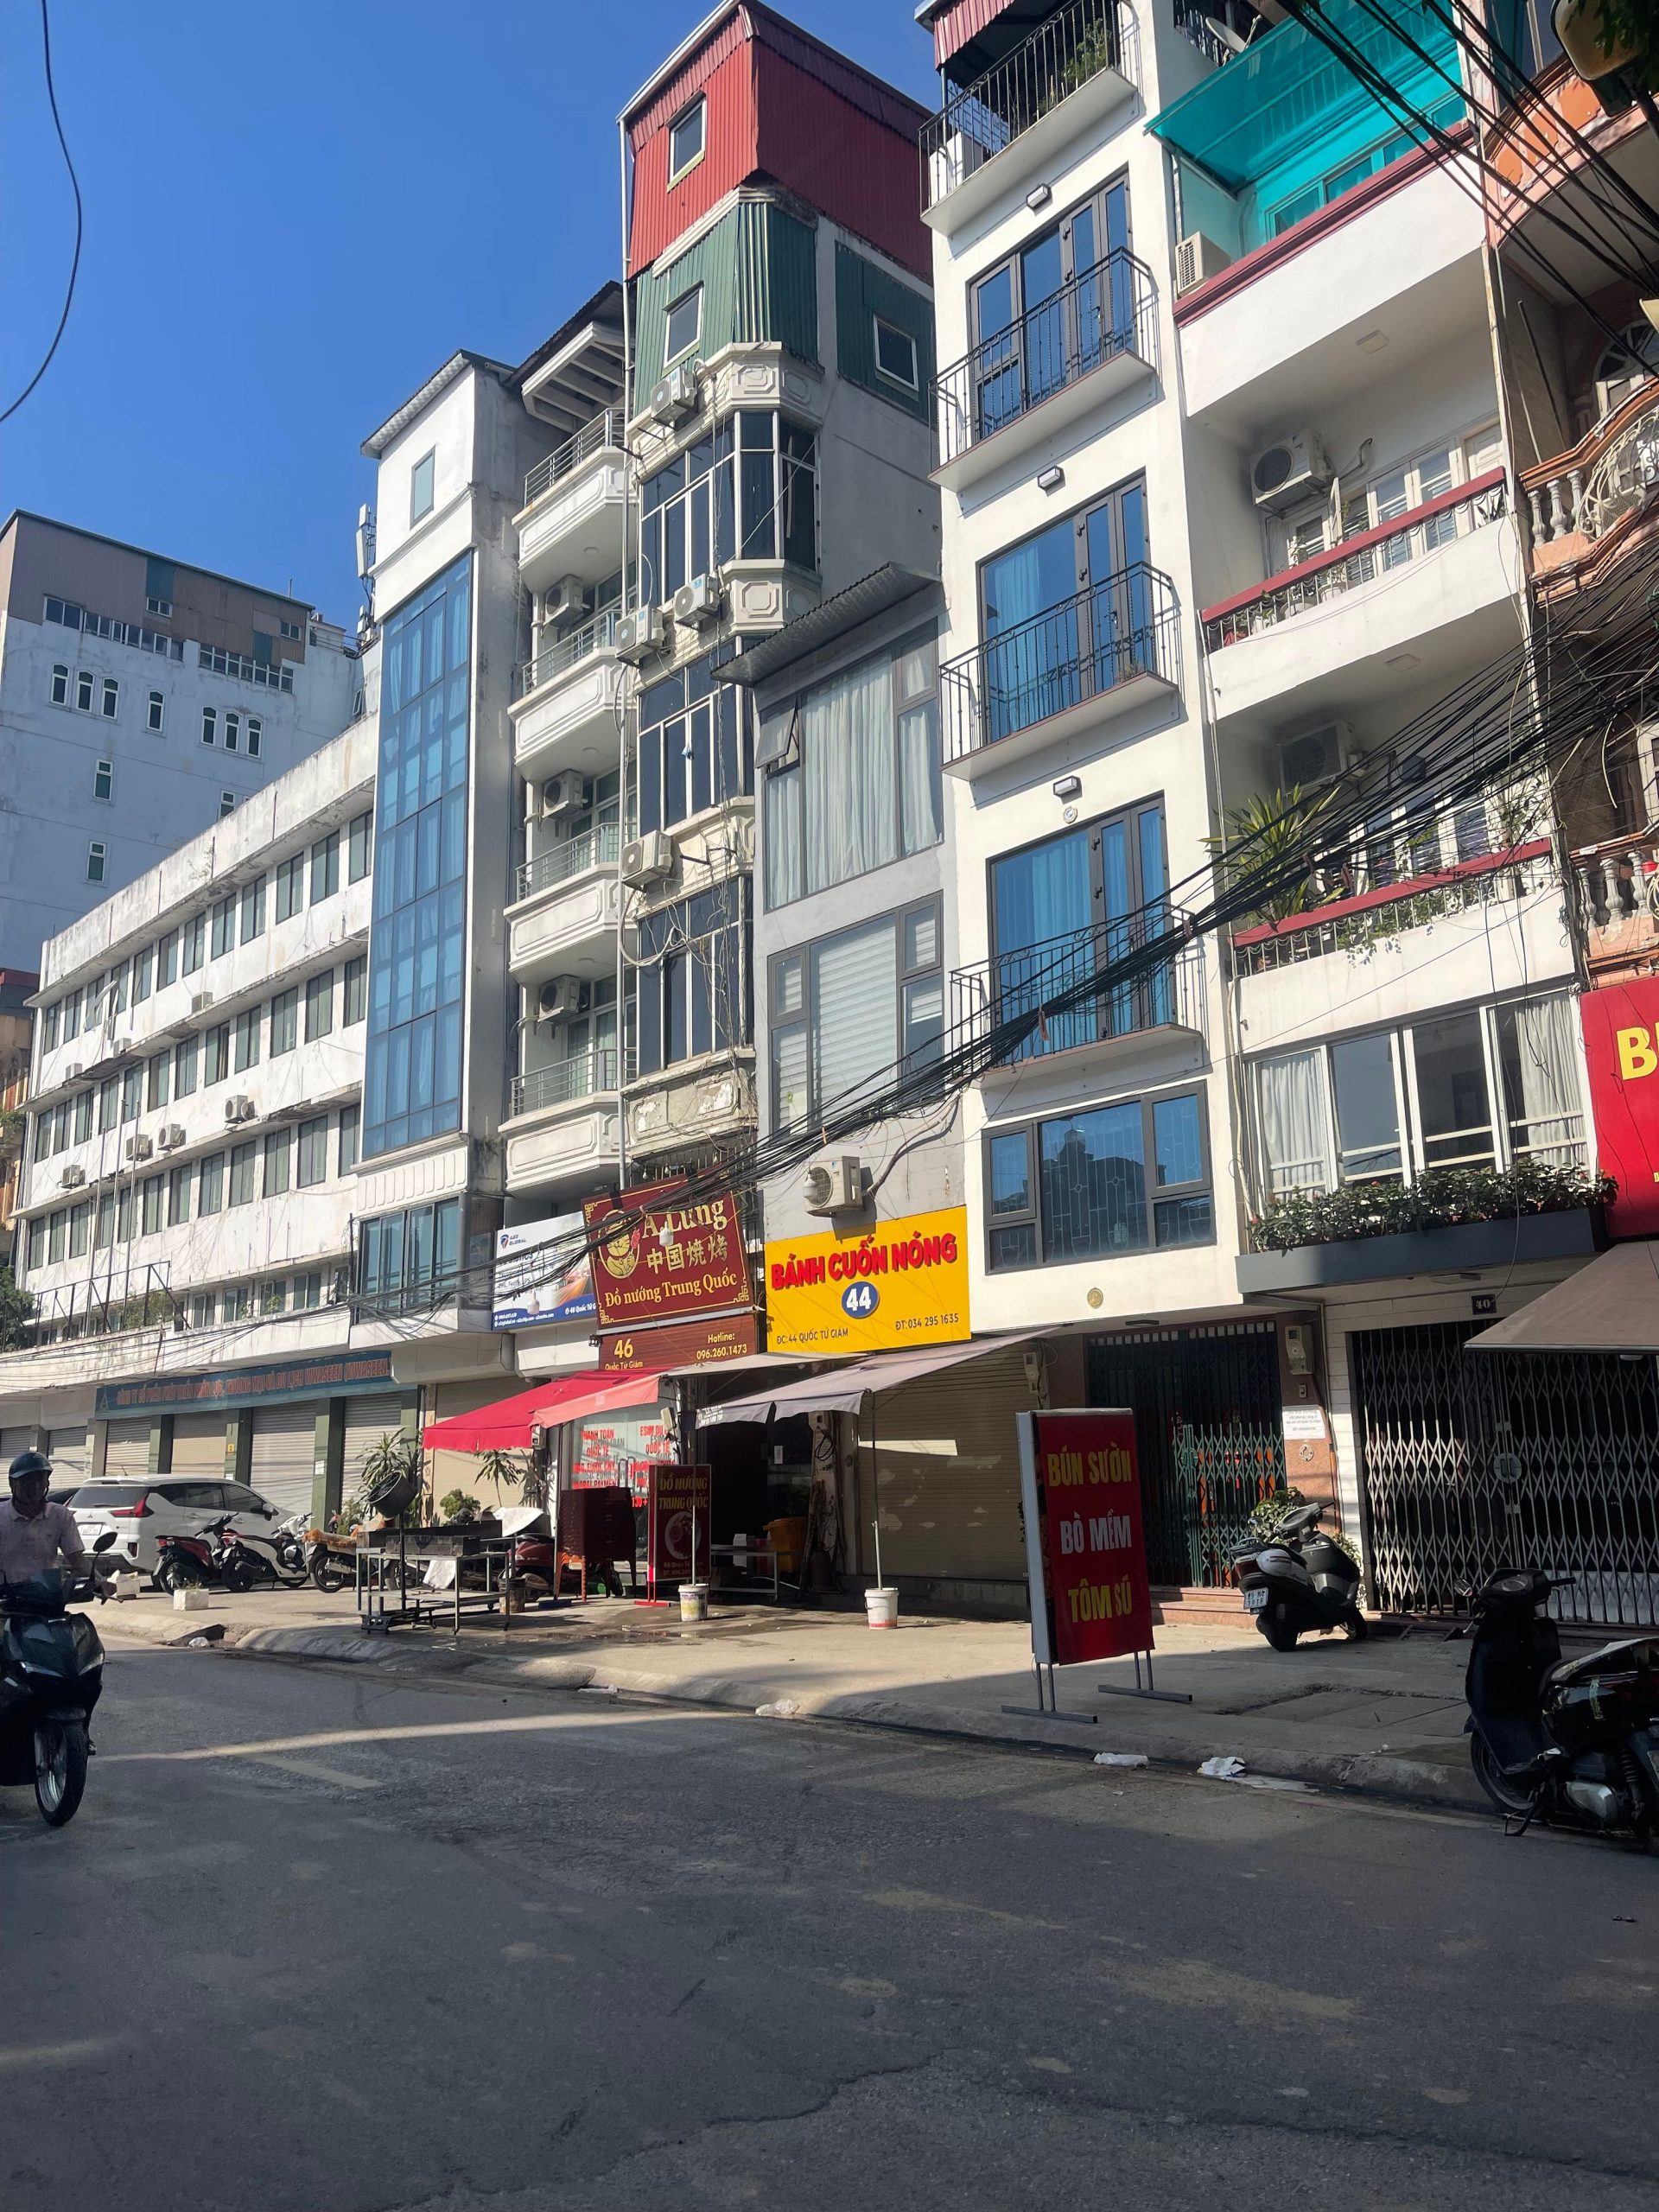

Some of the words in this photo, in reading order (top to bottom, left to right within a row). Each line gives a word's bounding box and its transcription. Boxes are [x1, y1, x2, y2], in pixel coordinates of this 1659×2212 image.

[1617, 1021, 1659, 1080] B
[771, 1253, 826, 1291] BÁNH
[828, 1234, 888, 1281] CUỐN
[891, 1230, 957, 1273] NÓNG
[605, 1288, 621, 1307] Đồ
[624, 1286, 662, 1305] nướng
[662, 1279, 702, 1298] Trung
[702, 1267, 738, 1293] Quốc
[846, 1286, 872, 1312] 44
[925, 1316, 938, 1327] 295
[940, 1313, 959, 1325] 1635
[708, 1332, 735, 1344] Hotline:
[799, 1326, 818, 1344] QUỐC
[831, 1325, 849, 1338] GIÁM
[613, 1338, 633, 1359] 46
[696, 1344, 747, 1360] 096.260.1473
[1046, 1445, 1084, 1487] BÚN
[1088, 1441, 1132, 1484] SƯỜN
[658, 1496, 685, 1510] TRUNG
[1060, 1511, 1084, 1554] BÒ
[1090, 1509, 1132, 1552] MỀM
[1068, 1578, 1113, 1624] TÔM
[1114, 1573, 1132, 1618] SÚ
